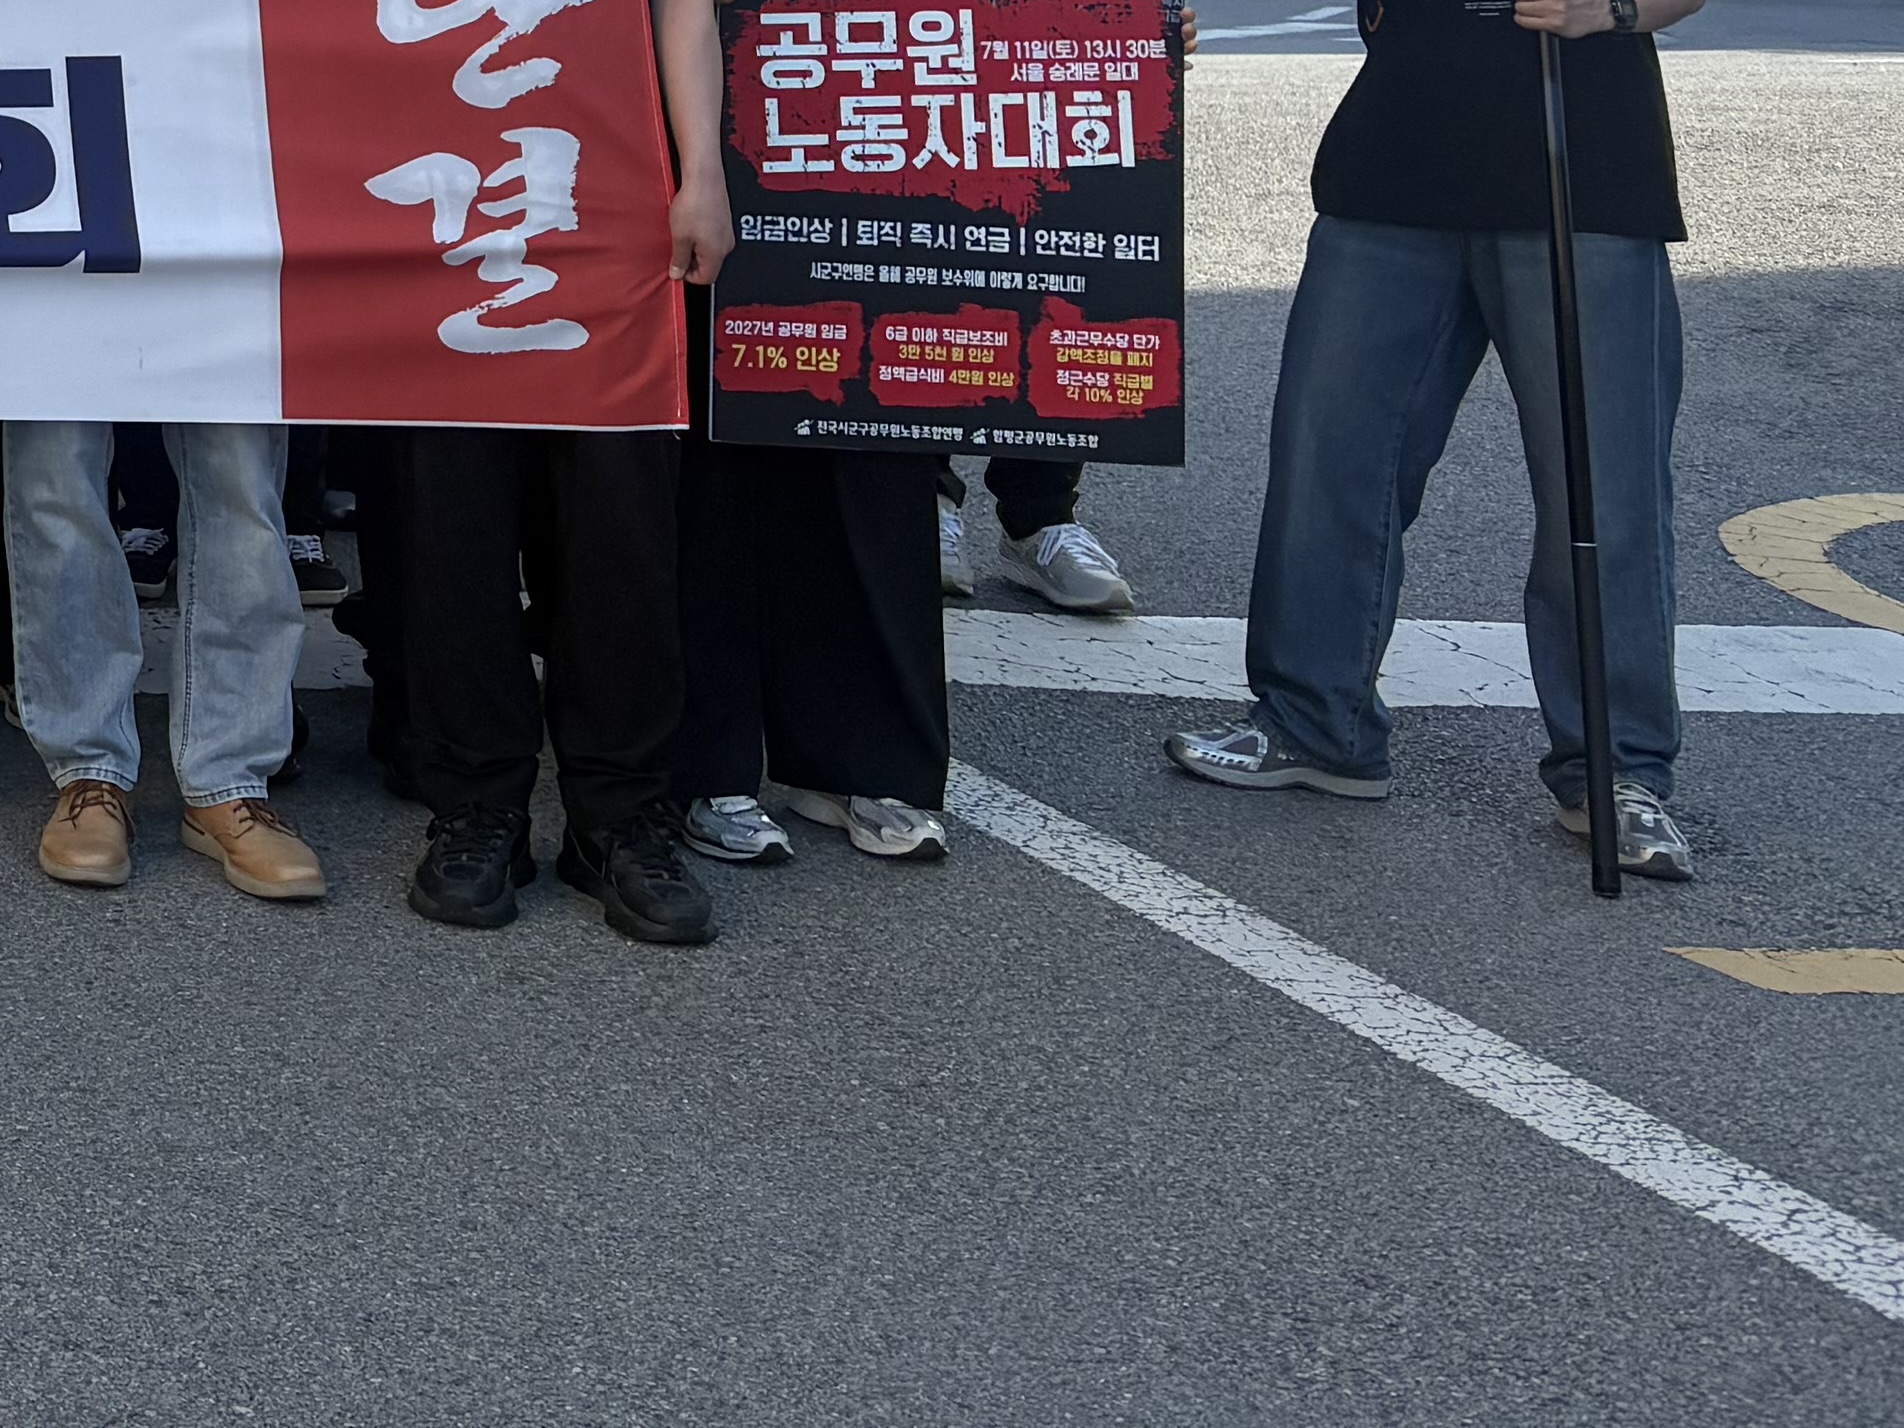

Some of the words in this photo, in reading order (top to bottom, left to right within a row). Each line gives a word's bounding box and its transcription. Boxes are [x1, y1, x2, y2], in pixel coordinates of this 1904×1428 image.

[757, 9, 977, 88] 공무원
[981, 41, 1009, 59] 7월
[1015, 40, 1078, 59] 11일(토)
[1085, 40, 1120, 58] 13시
[1126, 39, 1166, 58] 30분
[1011, 63, 1044, 81] 서울
[1049, 62, 1100, 81] 숭례문
[1105, 62, 1138, 81] 일대
[763, 90, 1135, 172] 노동자대회
[740, 215, 833, 243] 임금인상
[856, 220, 902, 247] 퇴직
[909, 223, 956, 250] 즉시
[964, 225, 1011, 253] 연금
[1034, 229, 1107, 258] 안전한
[1113, 234, 1160, 262] 일터
[905, 266, 938, 285] 공무원
[1027, 273, 1085, 293] 요구합니다!
[725, 320, 774, 336] 2027년
[778, 322, 817, 338] 공무원
[821, 324, 847, 340] 임금
[885, 326, 908, 342] 6급
[912, 327, 938, 343] 이하
[942, 328, 1008, 346] 직급보조비
[1049, 329, 1130, 349] 초과근무수당
[1133, 334, 1160, 350] 단가
[732, 344, 788, 368] 7.1%
[796, 346, 841, 372] 인상
[898, 344, 921, 360] 3만
[925, 345, 947, 361] 5천
[951, 347, 964, 362] 원
[968, 348, 994, 363] 인상
[1126, 351, 1153, 367] 폐지
[879, 365, 945, 384] 정액급식비
[948, 369, 984, 386] 4만원
[988, 371, 1015, 387] 인상
[1056, 369, 1110, 388] 정근수당
[1114, 372, 1153, 390] 직급별
[1066, 386, 1080, 401] 각
[1084, 387, 1113, 403] 10%
[1117, 389, 1144, 405] 인상
